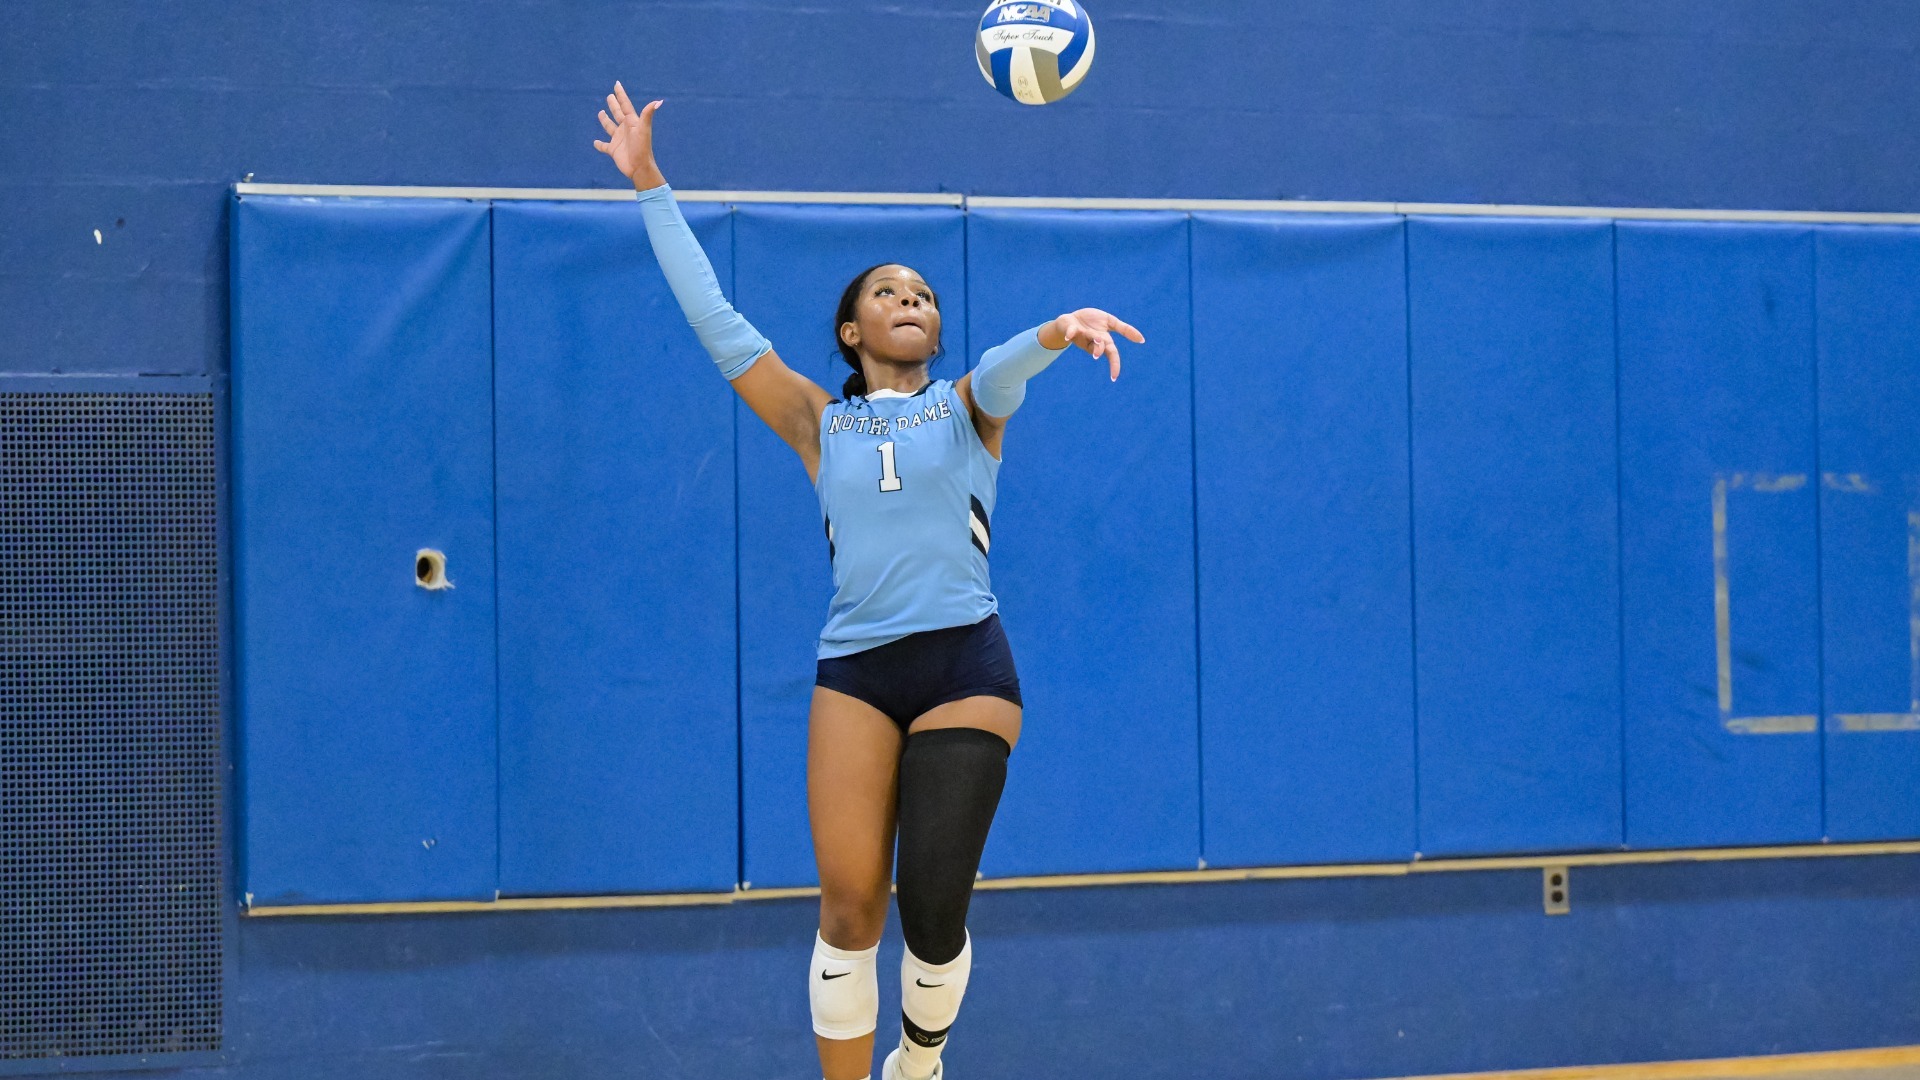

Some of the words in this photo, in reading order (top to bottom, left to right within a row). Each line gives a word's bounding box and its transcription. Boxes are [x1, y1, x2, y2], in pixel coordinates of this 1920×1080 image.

[997, 4, 1051, 23] NCAA
[993, 29, 1019, 43] Super
[1022, 29, 1054, 42] Touch
[896, 399, 951, 432] DAME
[876, 441, 902, 492] 1
